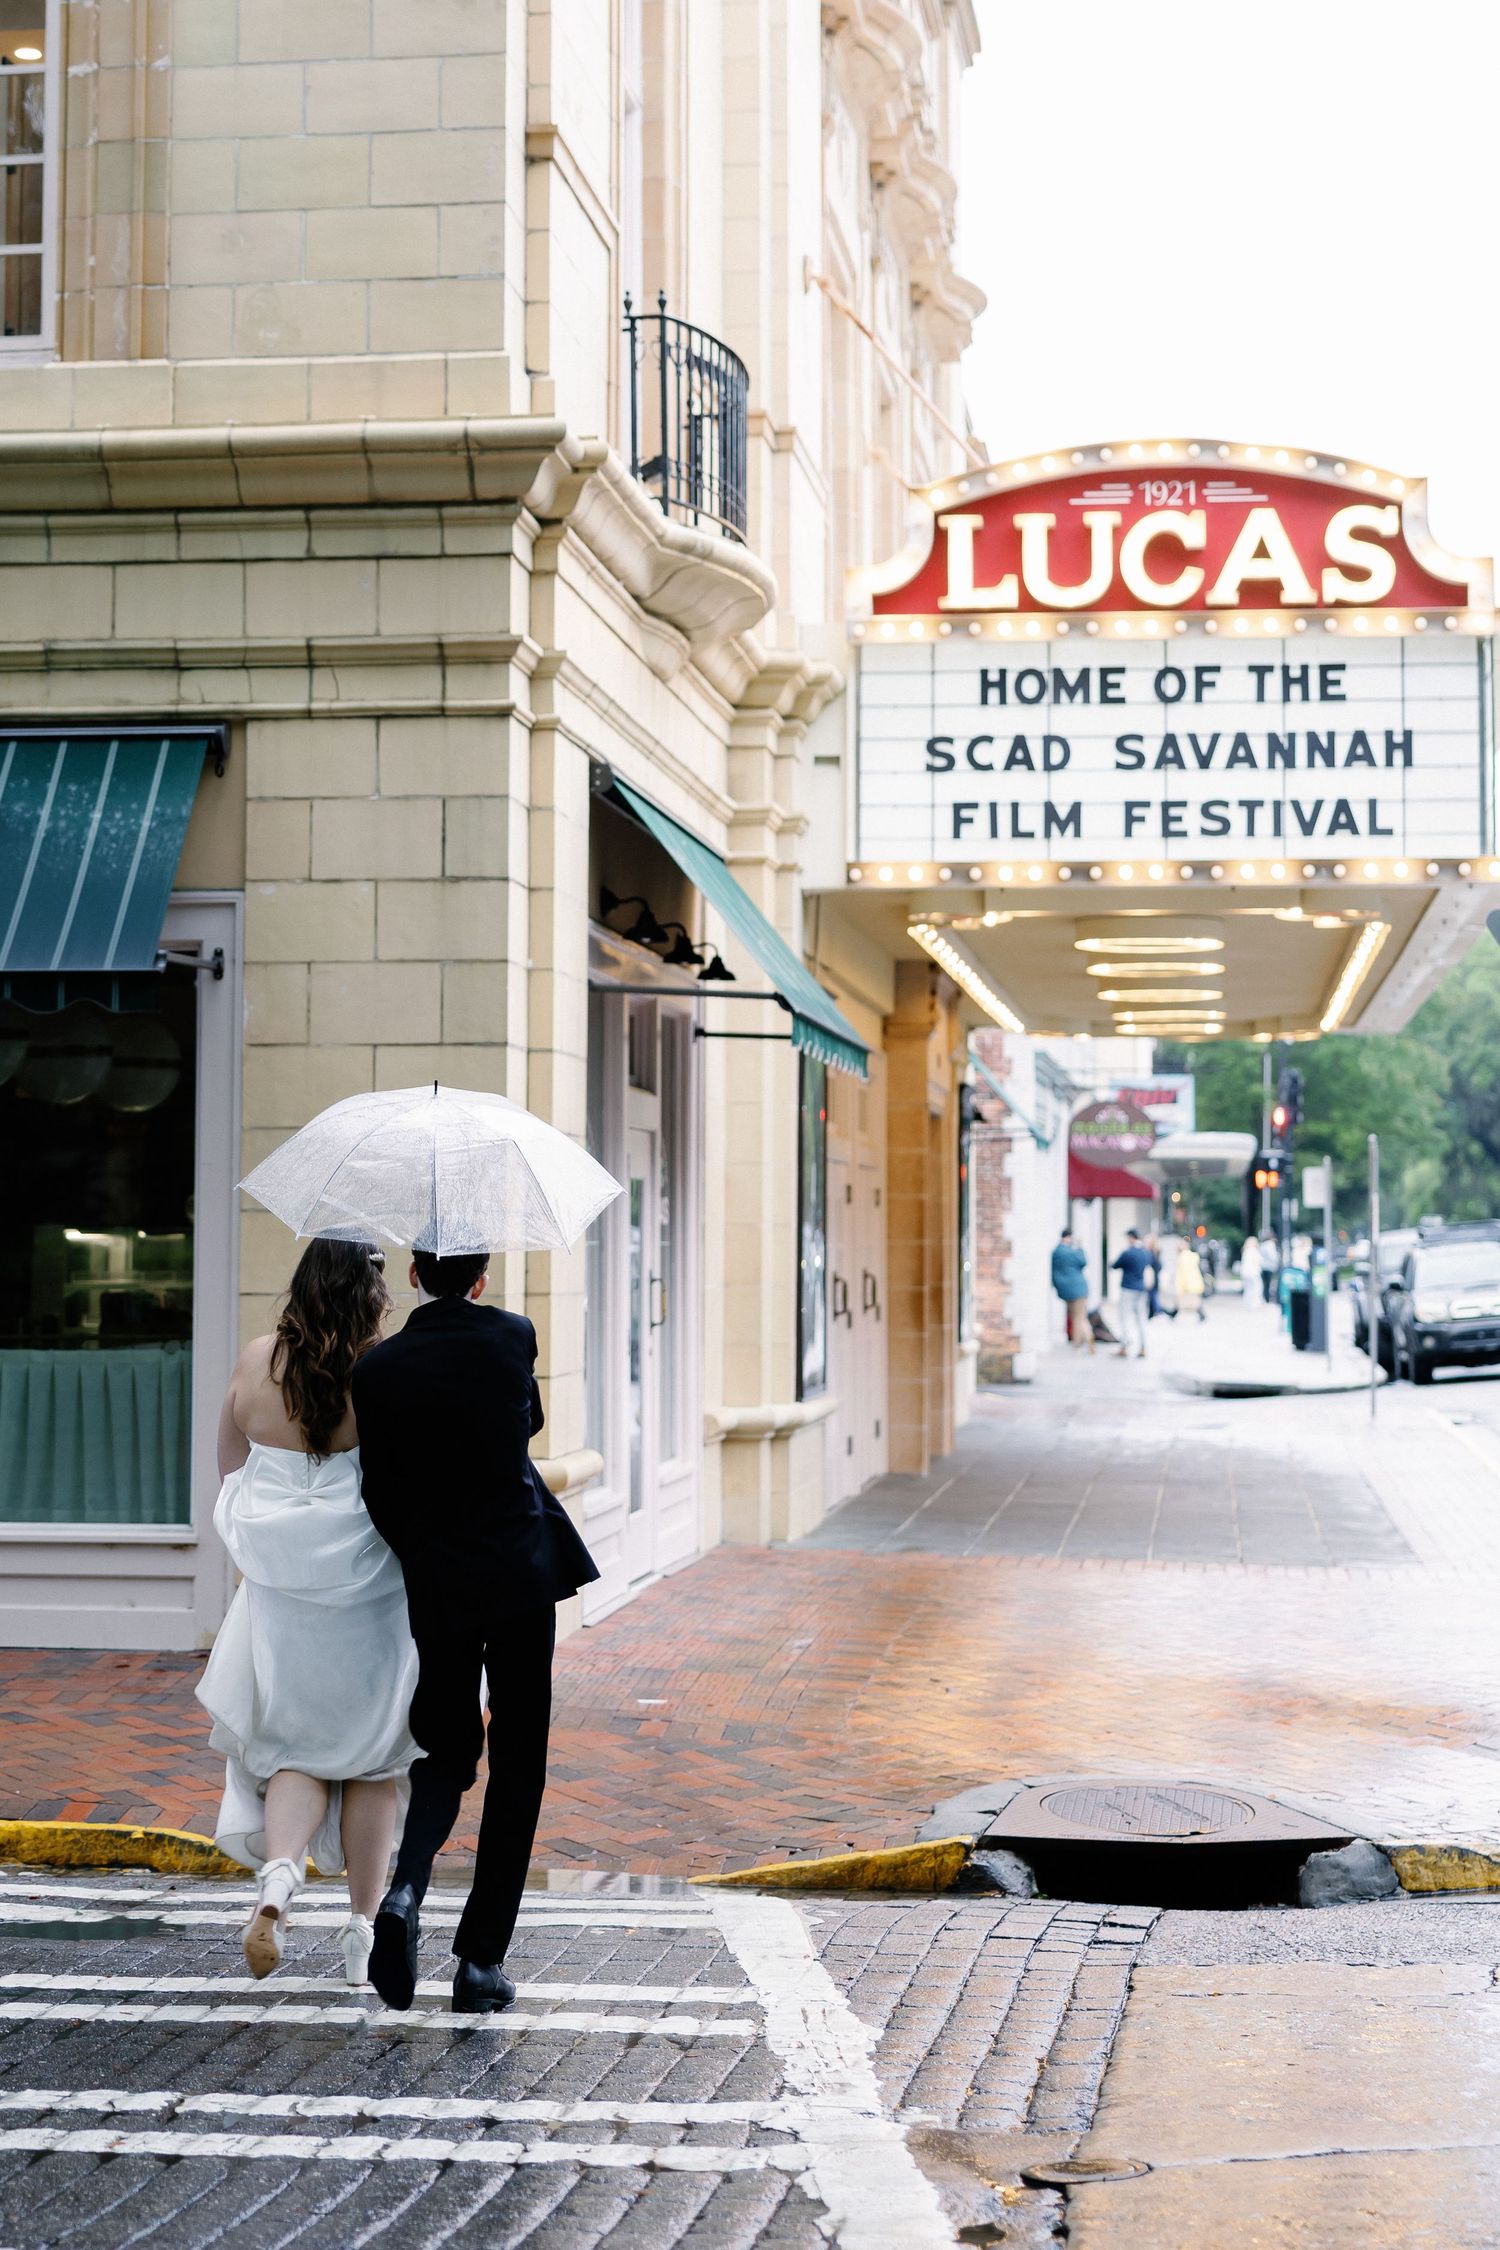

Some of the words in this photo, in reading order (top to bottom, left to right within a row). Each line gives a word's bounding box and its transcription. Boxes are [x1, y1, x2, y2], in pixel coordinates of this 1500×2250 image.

[1138, 479, 1197, 507] 1921
[937, 503, 1401, 611] LUCAS
[979, 665, 1127, 706] HOME
[1153, 664, 1222, 705] OF
[1247, 662, 1348, 704] THE
[925, 733, 1072, 774] SCAD
[1114, 728, 1414, 772] SAVANNAH
[951, 799, 1083, 840] FILM
[1123, 797, 1394, 839] FESTIVAL
